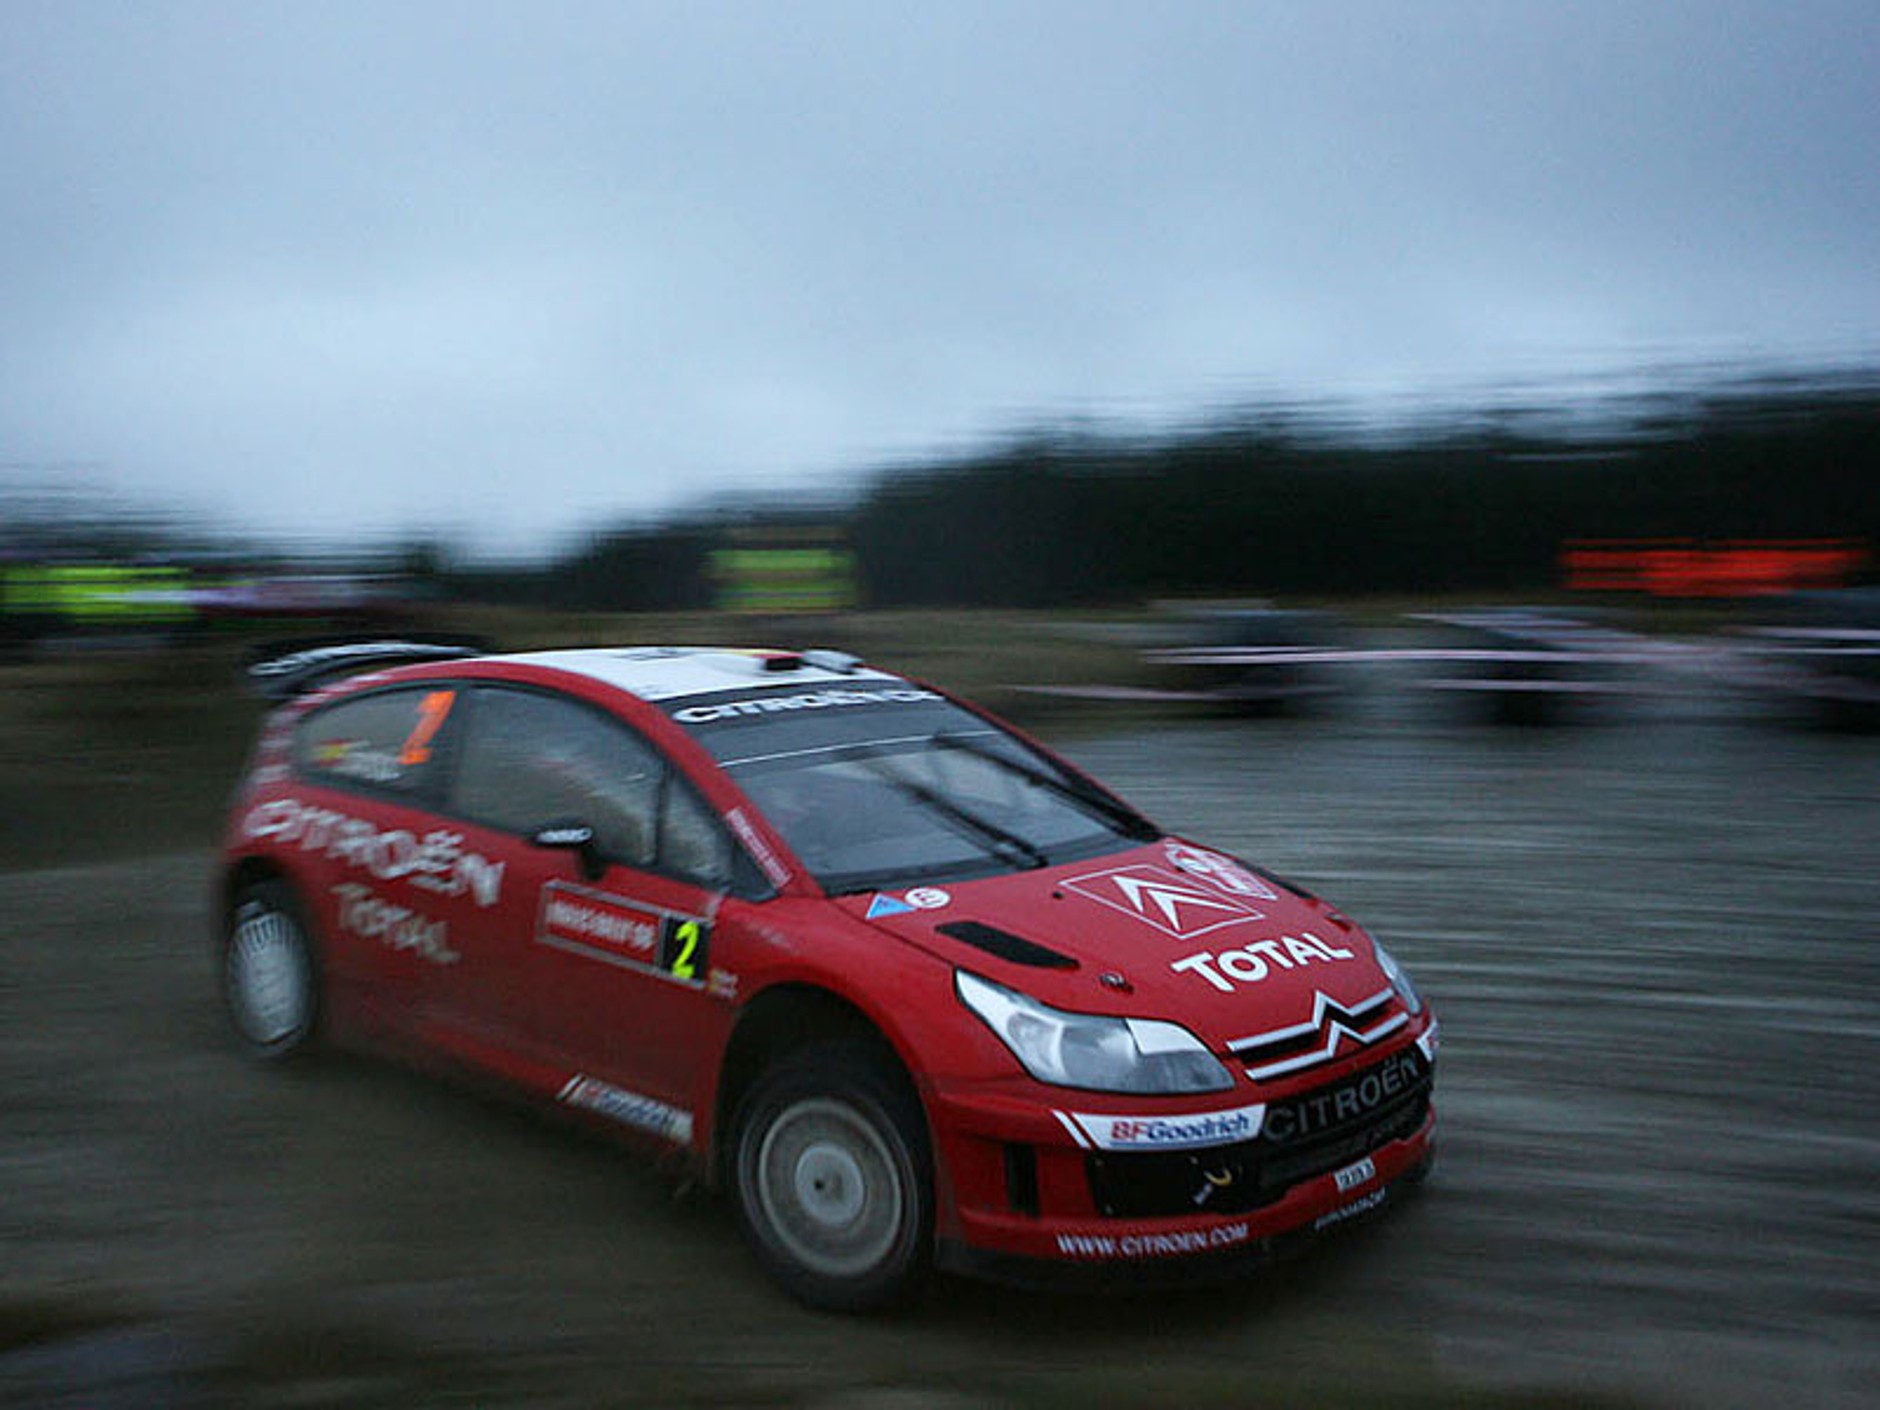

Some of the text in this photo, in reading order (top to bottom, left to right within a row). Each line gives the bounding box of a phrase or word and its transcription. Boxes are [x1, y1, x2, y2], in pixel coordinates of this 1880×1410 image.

[672, 919, 699, 979] 2
[1170, 932, 1354, 992] TOTAL
[1111, 1112, 1250, 1142] BFGoodrich
[1262, 1057, 1419, 1142] CITROËN
